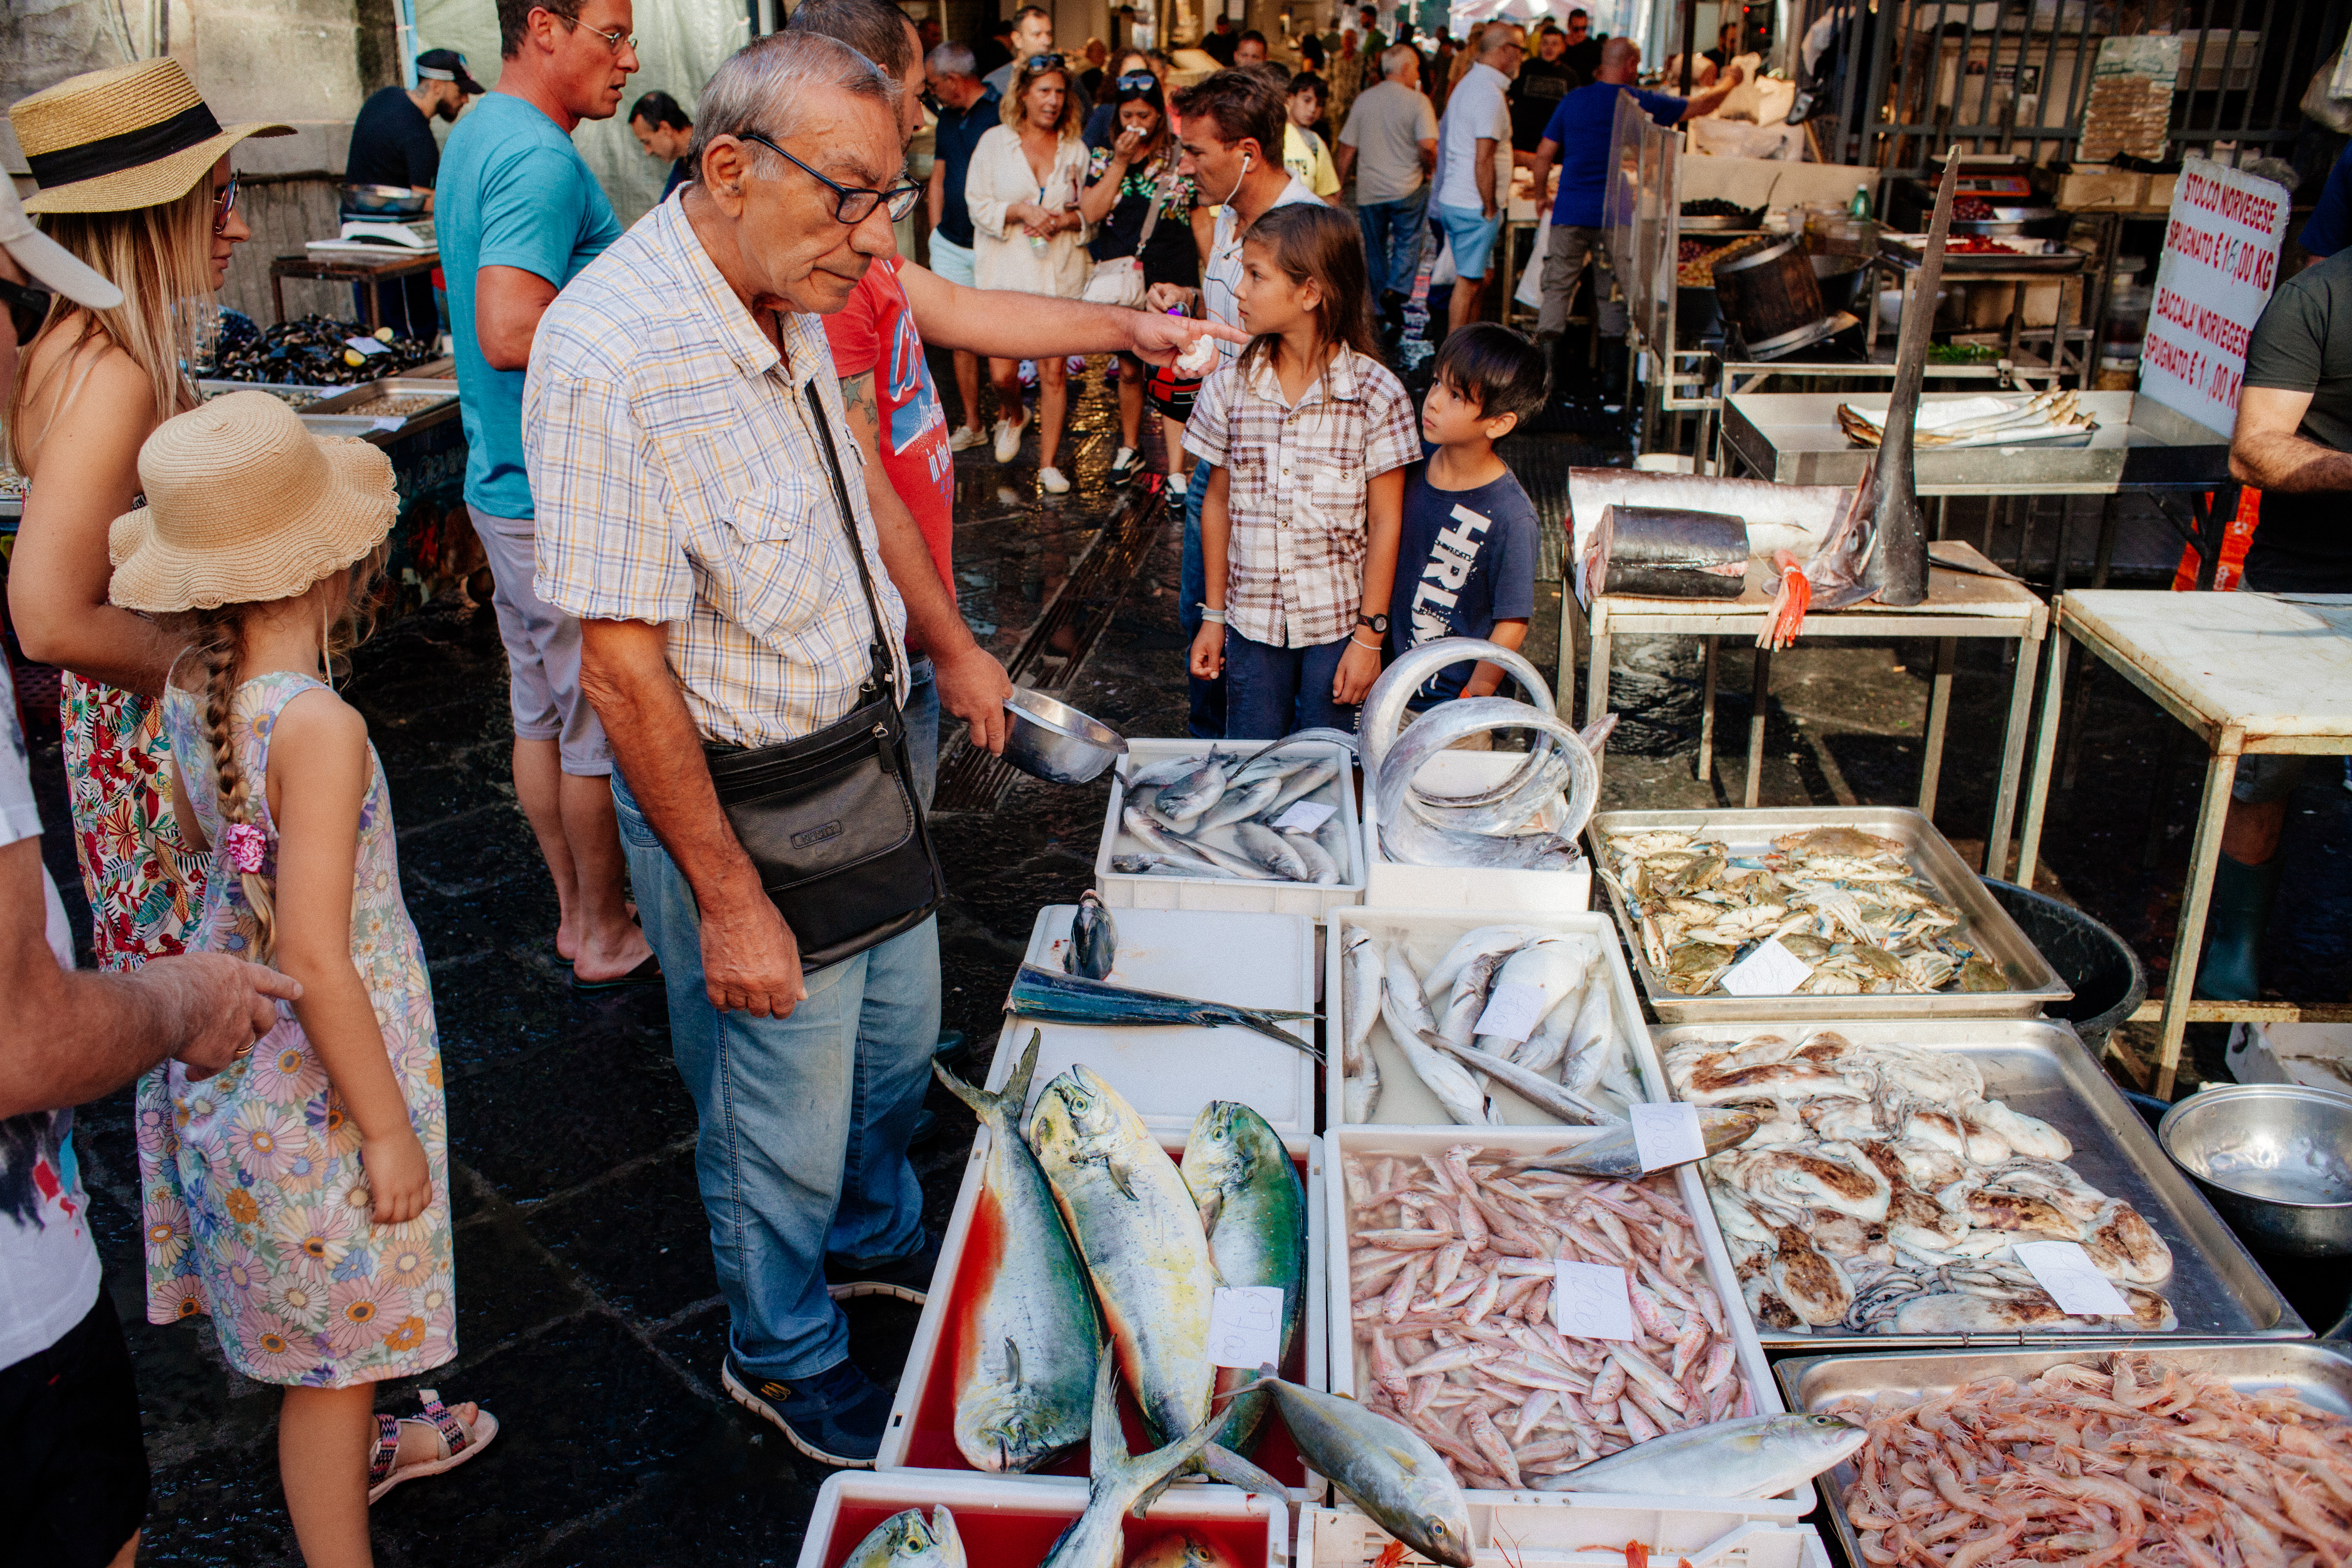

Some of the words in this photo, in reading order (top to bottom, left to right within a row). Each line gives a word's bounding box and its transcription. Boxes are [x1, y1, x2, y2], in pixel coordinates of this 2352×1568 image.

[2218, 184, 2277, 235] NORVEGESE
[2167, 219, 2213, 265] SPUGNATO
[2213, 232, 2224, 269] €
[2252, 248, 2274, 291] KG
[2144, 333, 2189, 380] SPUGNATO
